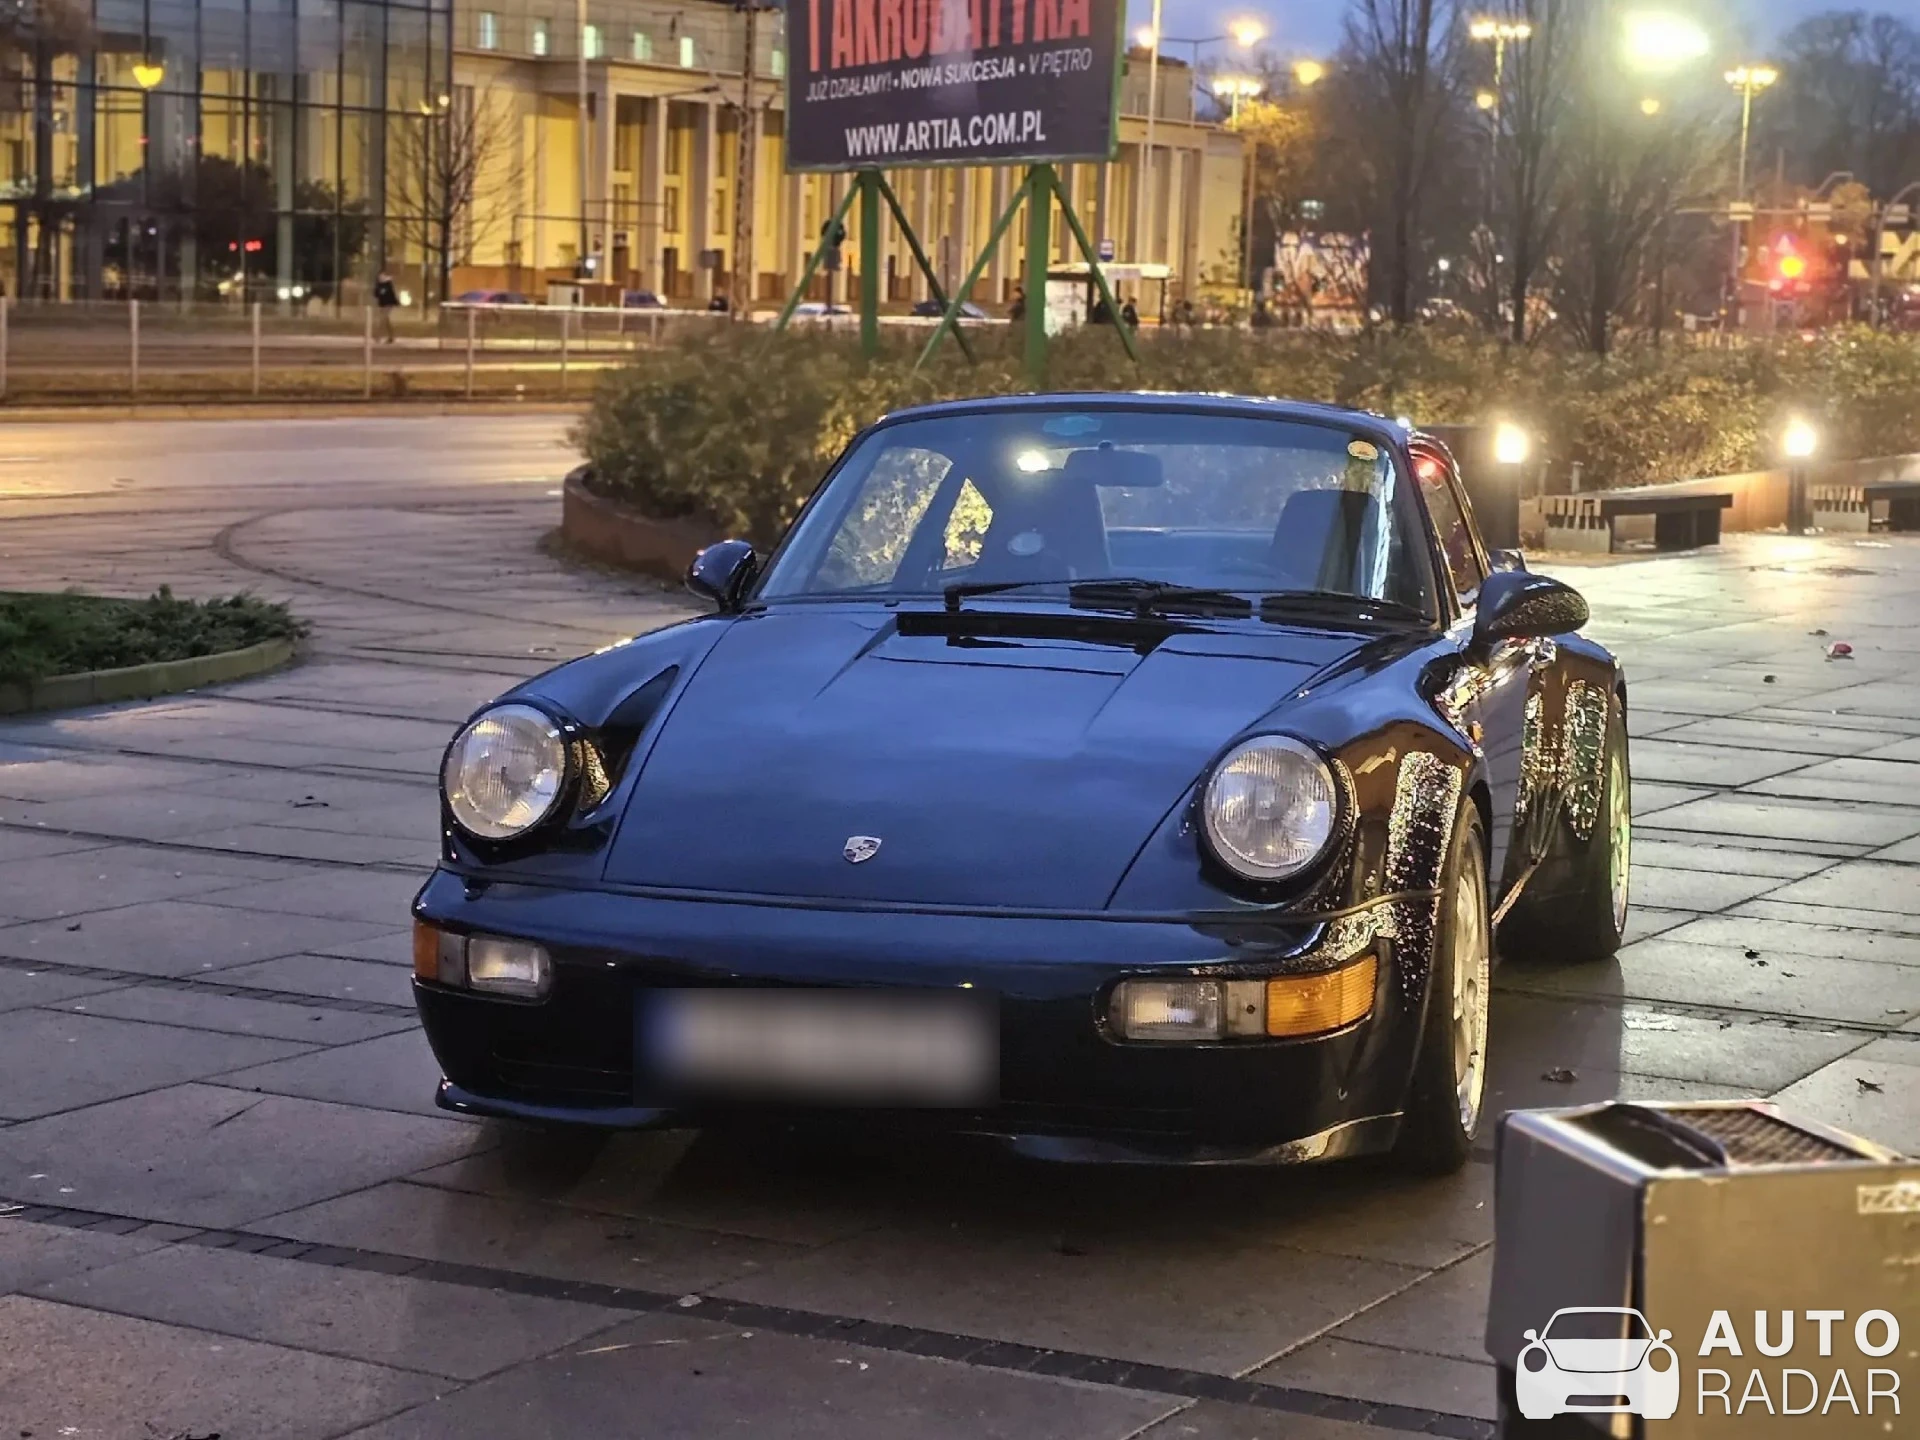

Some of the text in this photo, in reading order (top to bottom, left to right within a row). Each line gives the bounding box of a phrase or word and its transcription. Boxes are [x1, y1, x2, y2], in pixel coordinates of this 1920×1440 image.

[901, 65, 942, 90] NOWA
[944, 56, 1016, 85] SUKCESJA
[1029, 53, 1039, 75] V
[1041, 47, 1093, 78] PIĘTRO
[845, 110, 1046, 157] WWW.ARTIA.COM.PL
